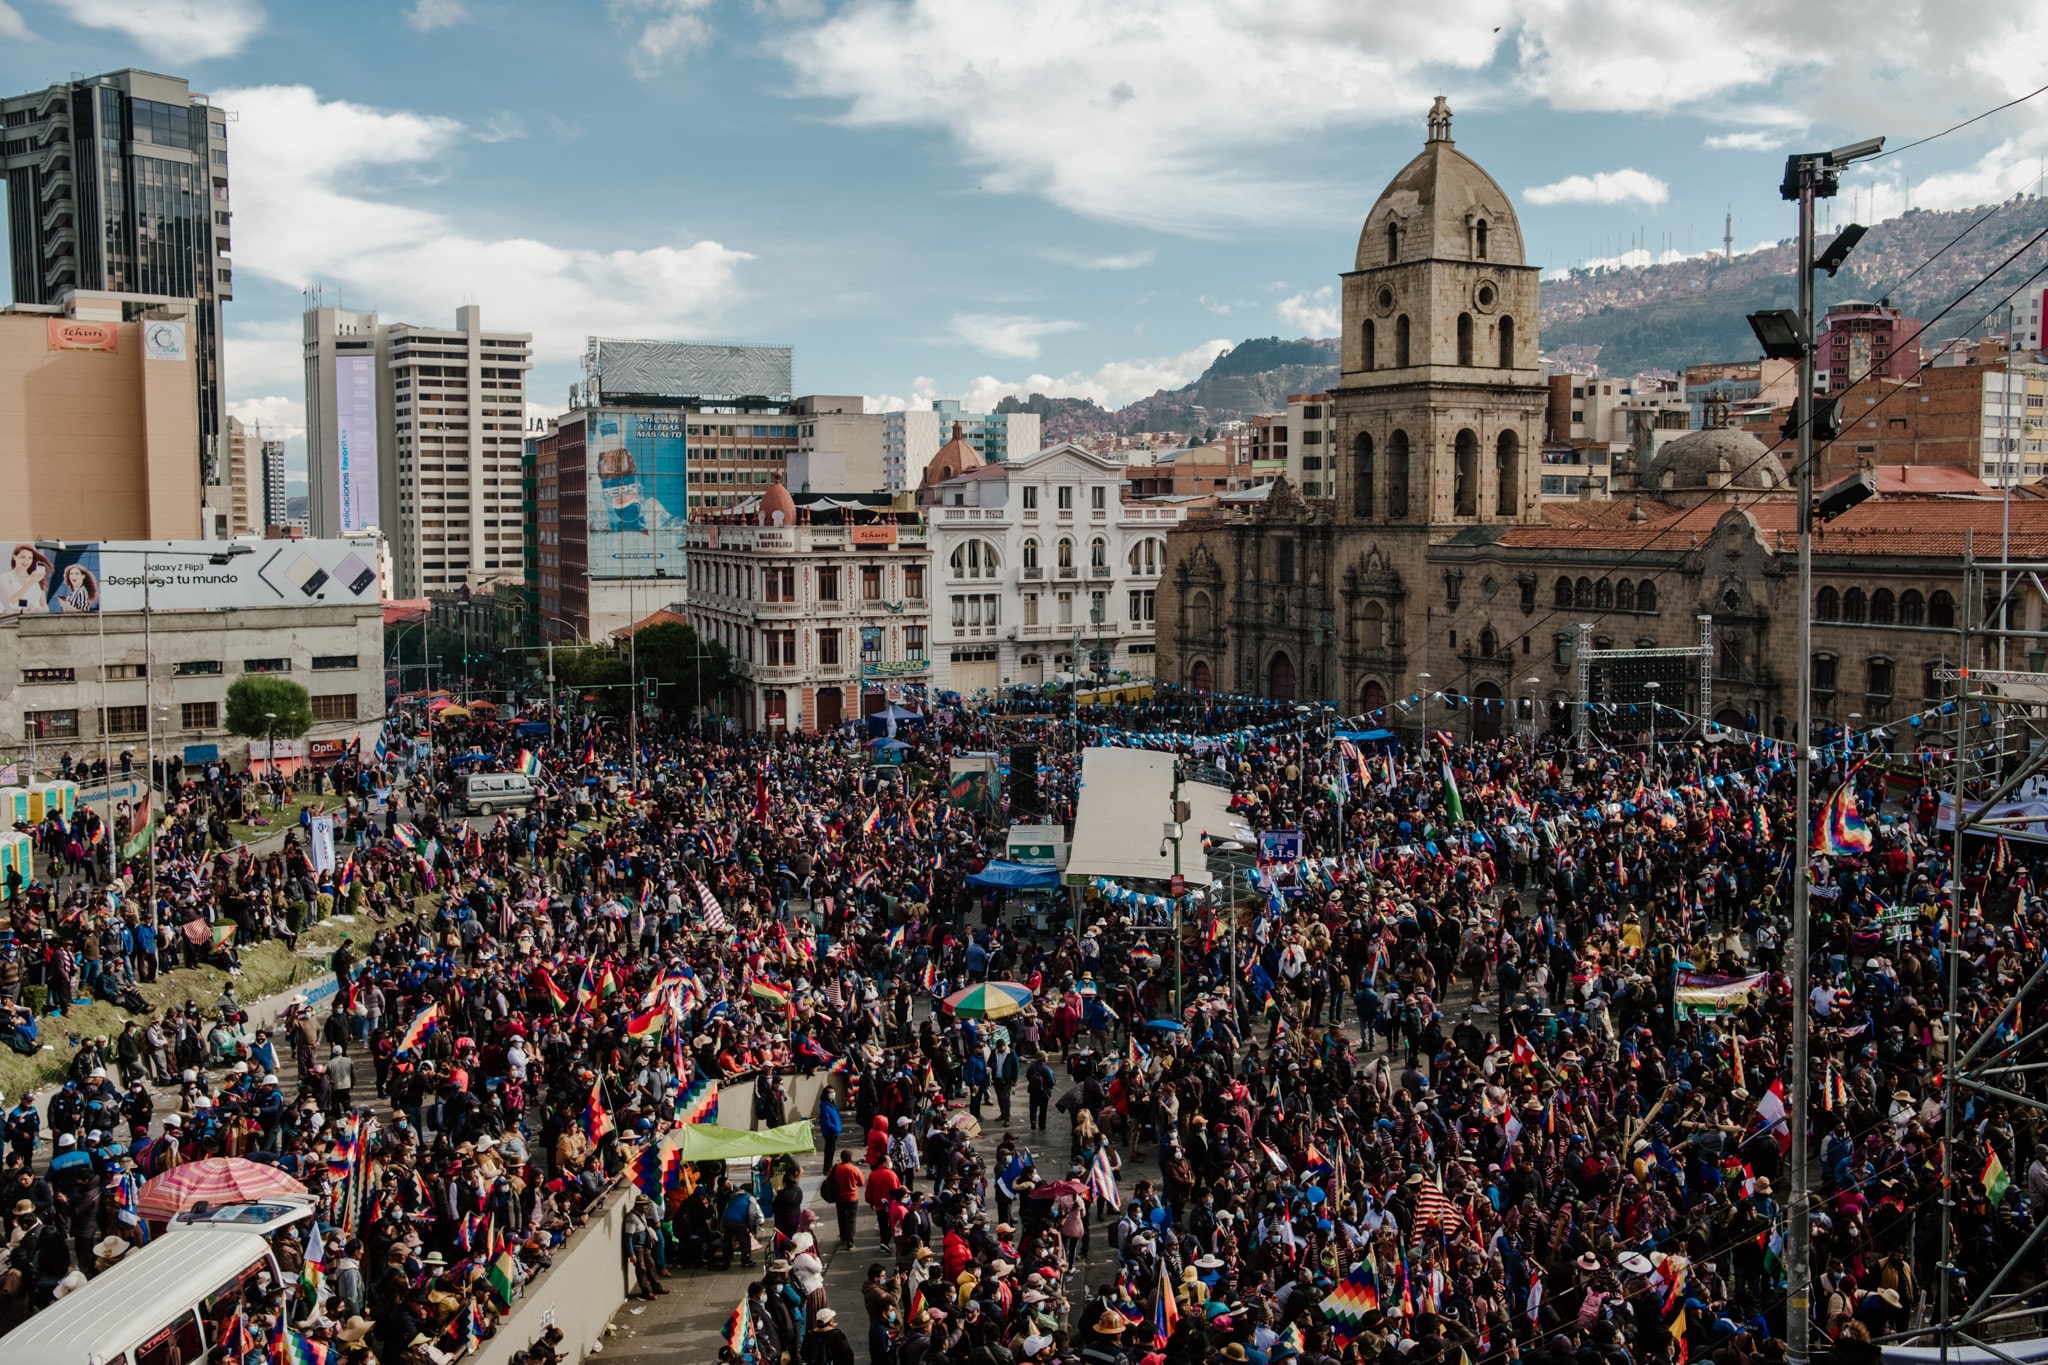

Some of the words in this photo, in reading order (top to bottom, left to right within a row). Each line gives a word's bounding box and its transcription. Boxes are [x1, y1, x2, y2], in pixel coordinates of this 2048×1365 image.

[341, 472, 352, 528] aplicaciones
[184, 562, 204, 572] Flip3
[108, 575, 174, 588] Desplga
[177, 575, 190, 585] tu
[192, 574, 238, 584] mundo
[876, 660, 924, 671] ABOGADOS
